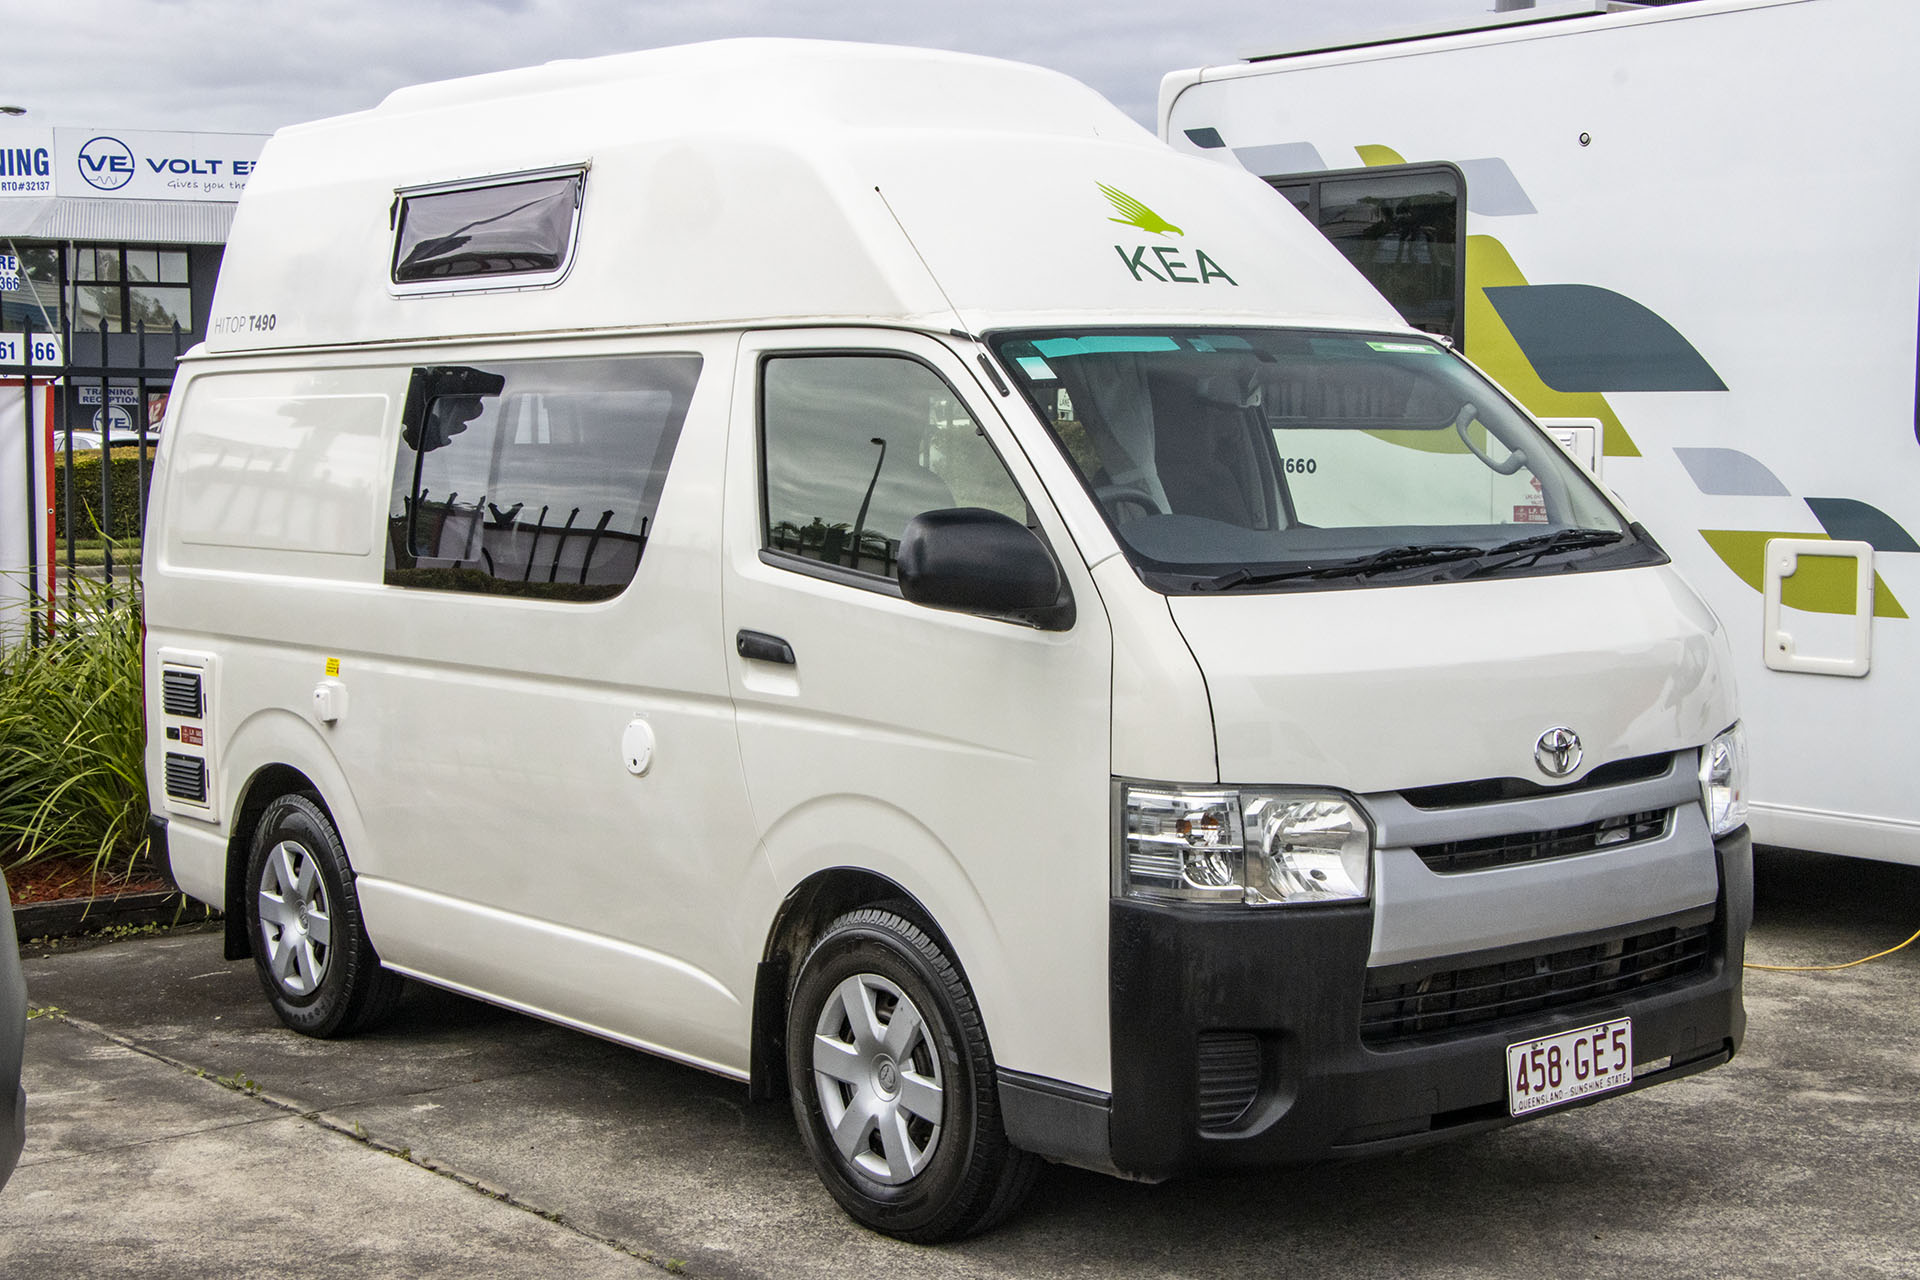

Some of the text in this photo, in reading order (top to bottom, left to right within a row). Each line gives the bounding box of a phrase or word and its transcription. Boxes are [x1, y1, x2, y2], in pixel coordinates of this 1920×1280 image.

[146, 158, 223, 175] VOLT
[1, 181, 50, 191] RTO#32137
[168, 179, 246, 193] Gives you the
[1114, 245, 1239, 287] KEA
[214, 313, 277, 334] HITOP T490
[31, 342, 56, 361] 66
[82, 396, 139, 404] RECPTION
[1281, 457, 1317, 474] 660
[1518, 1072, 1627, 1111] QUEENSLAND SUNSHINE STATE
